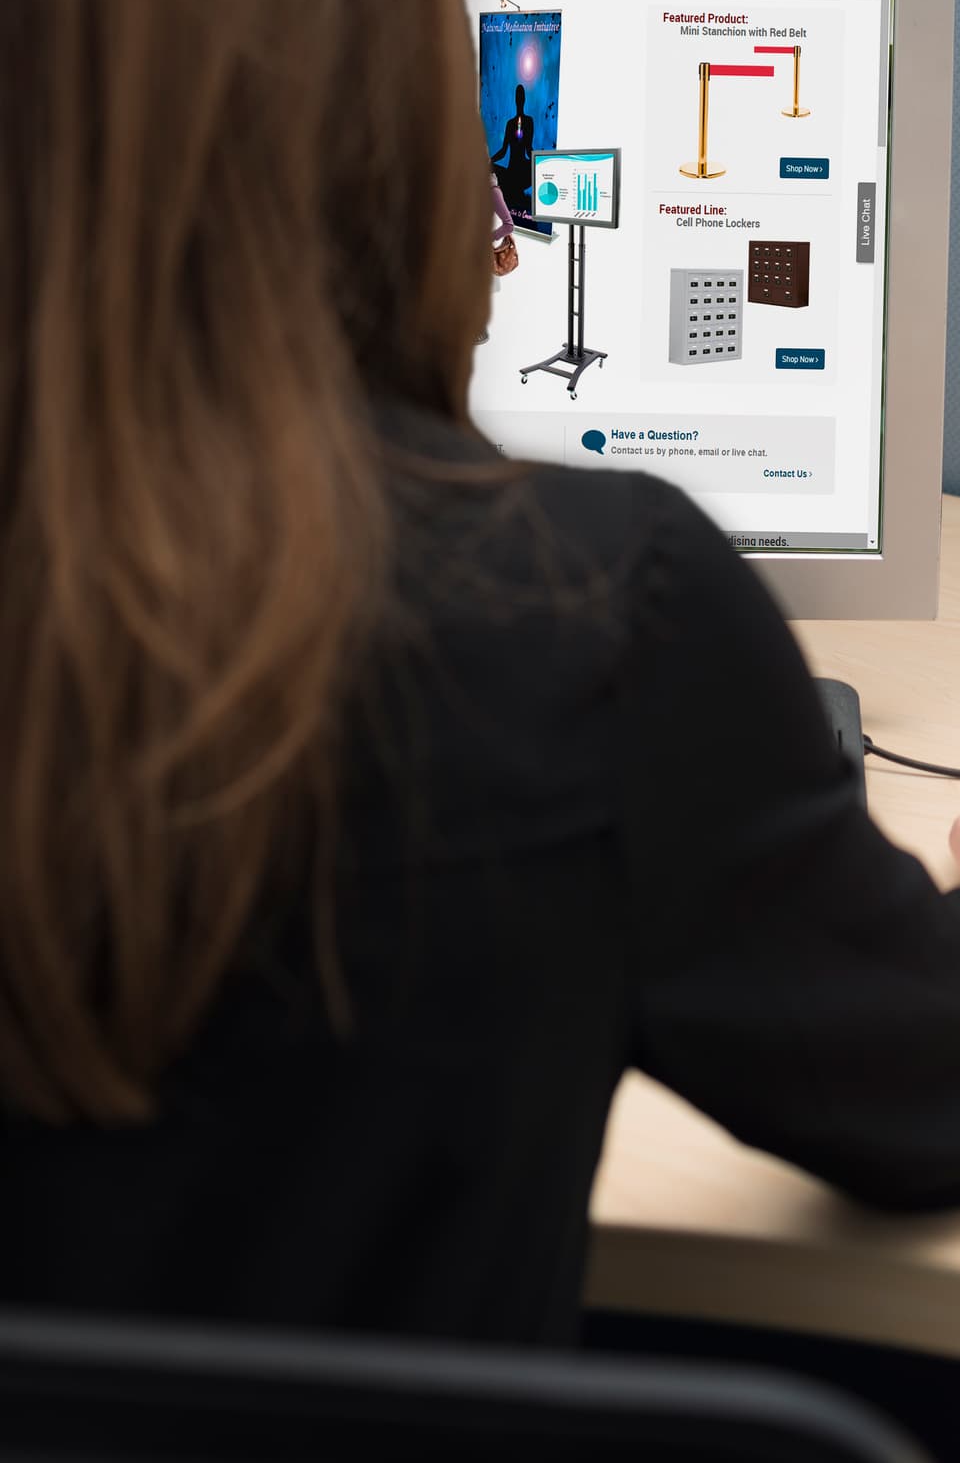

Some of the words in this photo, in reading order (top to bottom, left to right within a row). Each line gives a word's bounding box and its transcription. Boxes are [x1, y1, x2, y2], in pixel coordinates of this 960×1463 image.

[663, 12, 705, 23] Featured
[707, 13, 749, 24] Product:
[680, 26, 700, 36] Mini
[702, 27, 746, 37] Stanchion
[749, 27, 768, 37] with
[769, 28, 787, 37] Red
[789, 28, 807, 38] Belt
[786, 164, 803, 175] Shop
[804, 165, 819, 173] Now
[659, 204, 702, 215] Featured
[704, 205, 727, 215] Line:
[861, 198, 871, 223] Chat
[676, 218, 693, 227] Cell
[695, 218, 723, 228] Phone
[725, 219, 760, 228] Lockers
[861, 225, 870, 246] Live
[782, 355, 798, 365] Shop
[799, 355, 814, 363] Now
[611, 430, 636, 440] Have
[647, 430, 699, 441] Question?
[611, 446, 642, 455] Contact
[656, 447, 666, 457] by
[668, 447, 696, 457] phone,
[698, 447, 719, 456] email
[731, 448, 746, 456] live
[747, 448, 768, 457] chat.
[763, 469, 795, 478] Contact
[797, 470, 807, 478] Us
[758, 536, 789, 547] needs.
